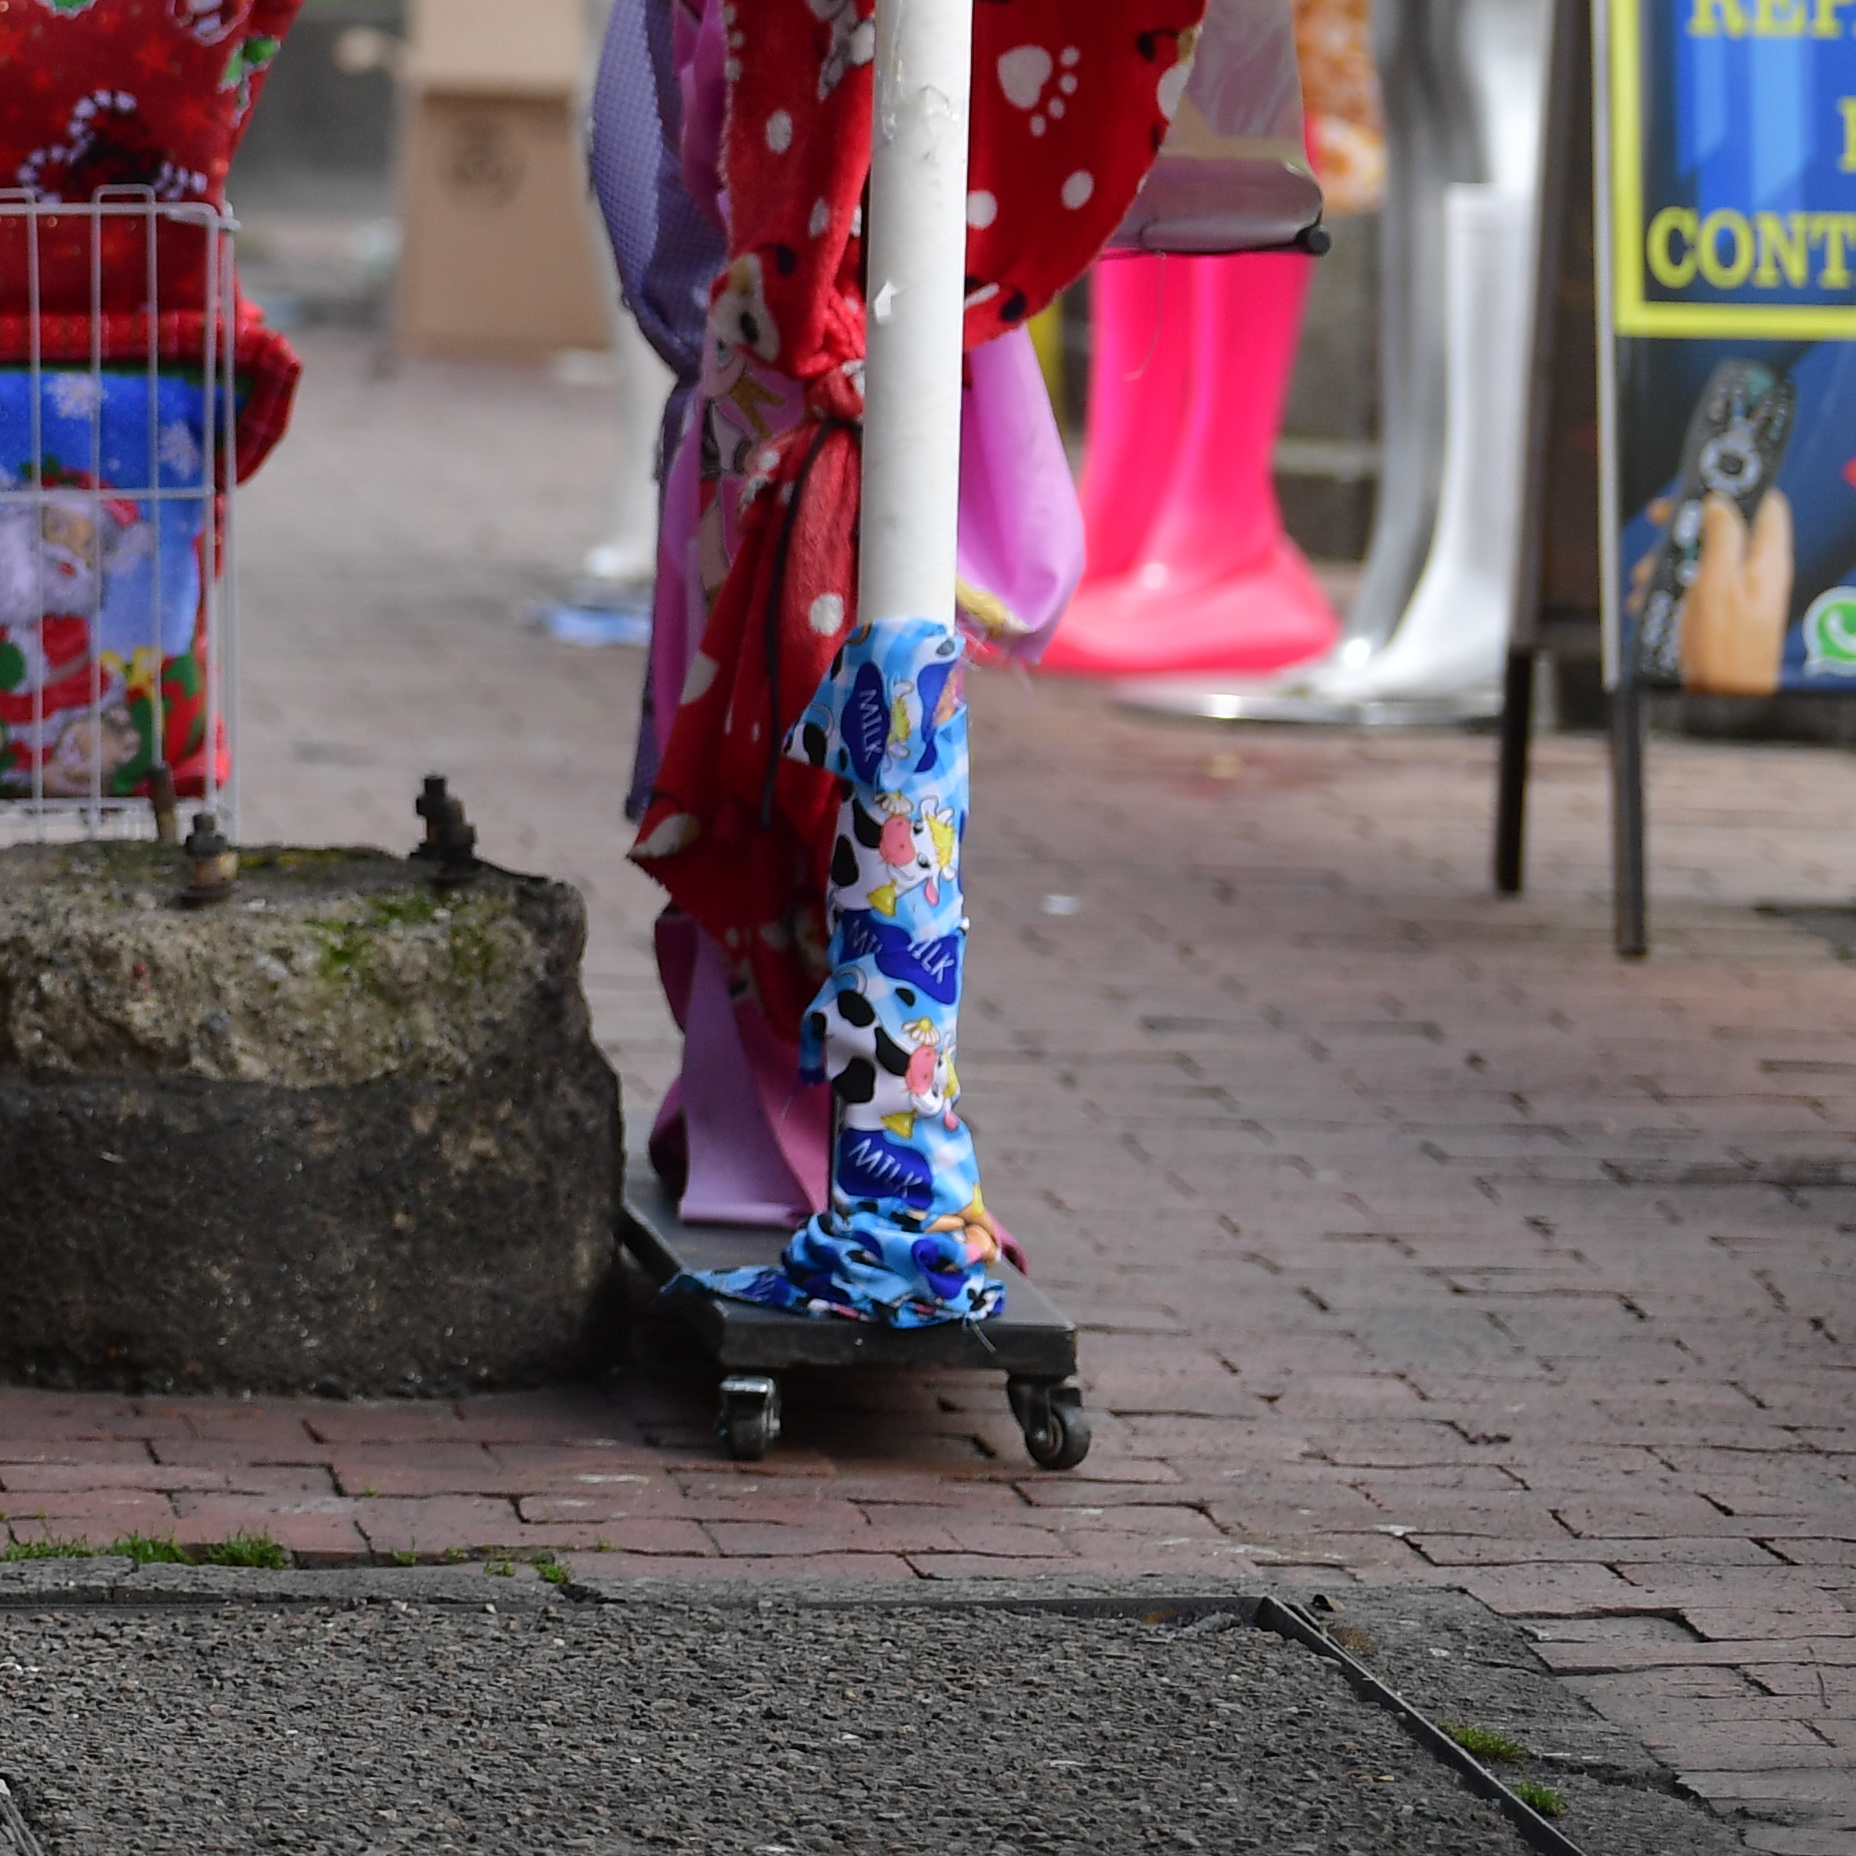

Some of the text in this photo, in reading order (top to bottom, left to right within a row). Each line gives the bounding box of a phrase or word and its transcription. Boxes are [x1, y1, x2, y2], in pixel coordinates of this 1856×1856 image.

[1646, 204, 1856, 290] CONT
[859, 687, 885, 765] MILK
[848, 1136, 924, 1201] MILK
